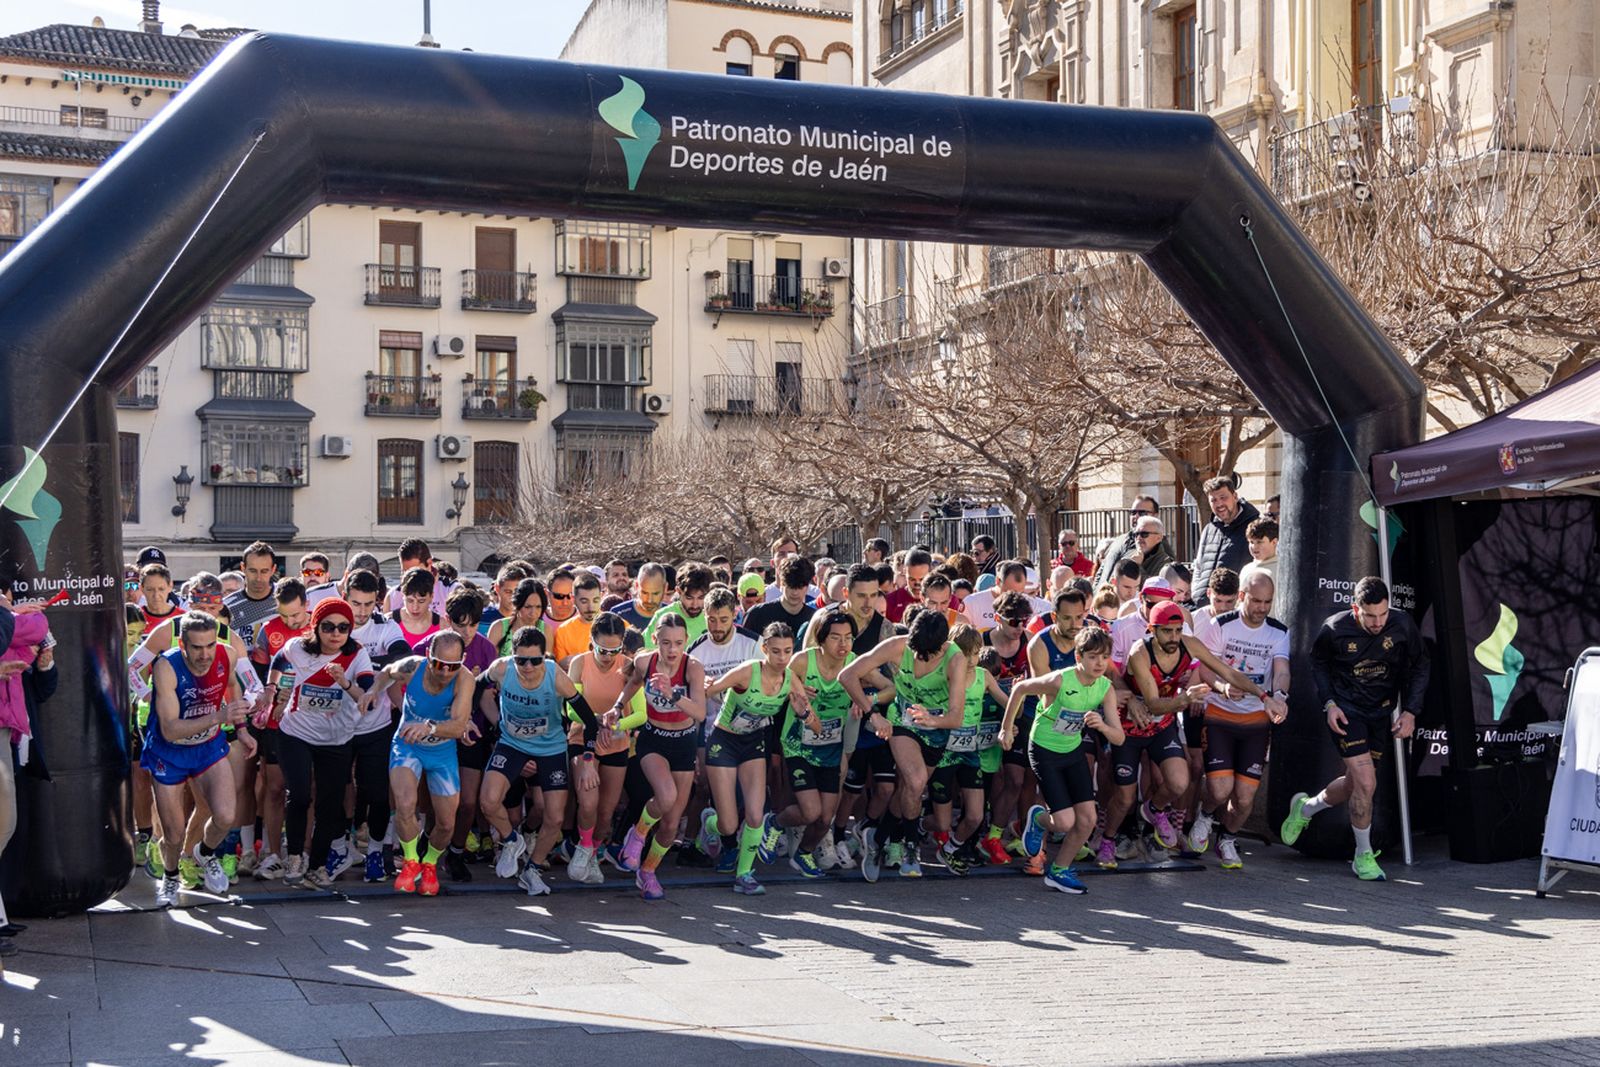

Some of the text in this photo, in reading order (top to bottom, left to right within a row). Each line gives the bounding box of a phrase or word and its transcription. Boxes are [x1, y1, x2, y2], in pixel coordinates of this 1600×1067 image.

[671, 116, 952, 158] Patronato Municipal de
[670, 146, 888, 182] Deportes de Jaén
[1400, 470, 1420, 480] Patronato
[1421, 466, 1440, 476] Municipal
[1400, 479, 1418, 487] Deportes
[1425, 475, 1436, 483] Jaén
[33, 575, 100, 591] Municipal
[103, 574, 115, 587] de
[73, 591, 104, 606] Jaén
[308, 697, 333, 708] 697
[653, 729, 682, 738] NIKE
[951, 736, 973, 747] 749
